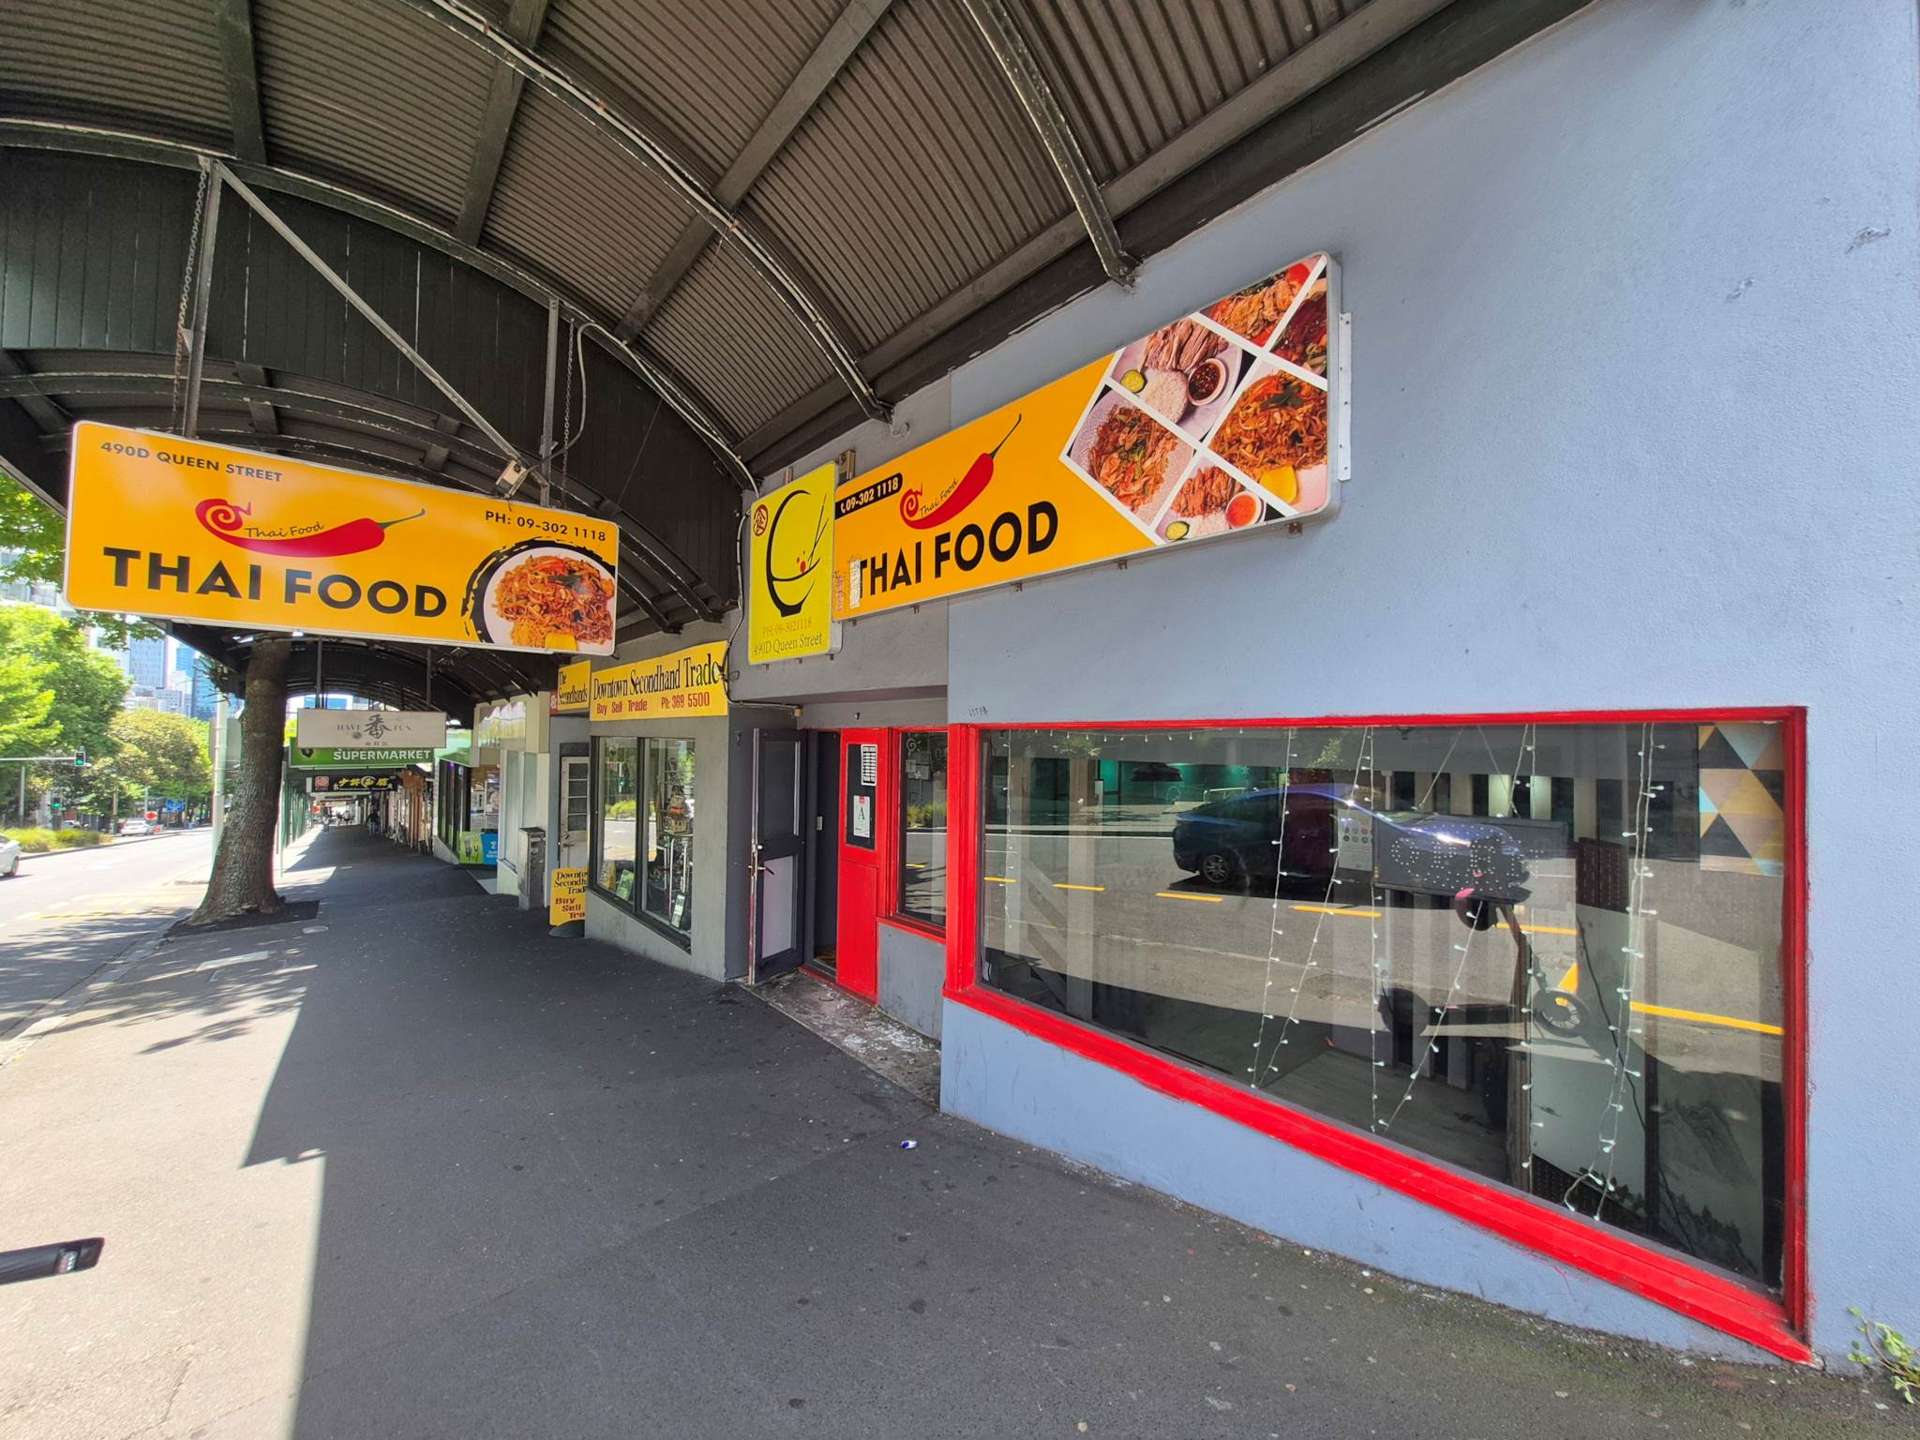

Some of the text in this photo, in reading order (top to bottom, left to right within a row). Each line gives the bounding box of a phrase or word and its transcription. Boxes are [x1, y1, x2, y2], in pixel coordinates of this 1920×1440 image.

[100, 442, 283, 483] 490D QUEEN STREET
[876, 476, 900, 498] 1118
[245, 521, 325, 538] Thai Food
[485, 510, 607, 542] PH: 09-302 1118
[934, 501, 1059, 579] FOOD
[103, 546, 448, 618] THAI FOOD
[772, 638, 798, 654] Queen
[799, 631, 823, 649] Street
[593, 677, 628, 701] Downtown
[630, 661, 681, 695] Secondhand
[596, 702, 608, 716] Buy
[627, 699, 648, 712] Trade
[687, 691, 711, 708] 5500
[333, 749, 432, 761] SUPERMARKET
